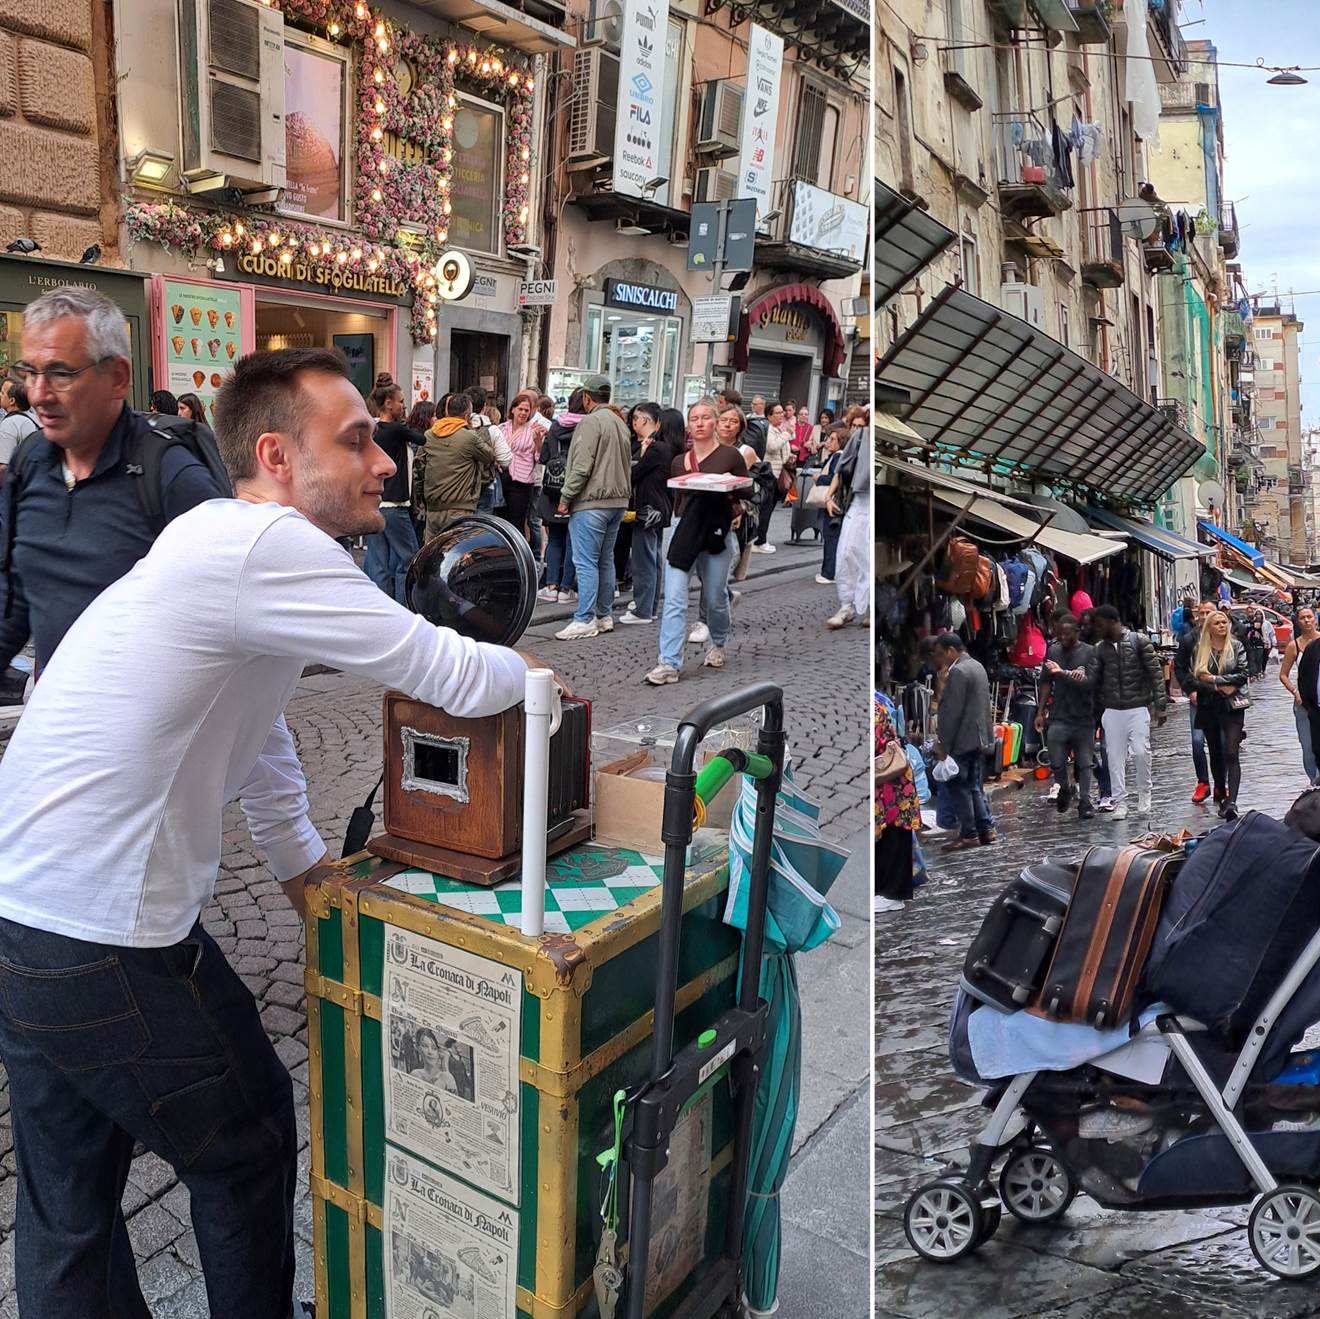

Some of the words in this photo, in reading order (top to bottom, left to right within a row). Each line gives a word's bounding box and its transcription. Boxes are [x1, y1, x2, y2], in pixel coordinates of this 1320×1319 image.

[636, 12, 653, 31] PUMA
[636, 57, 652, 69] adidas
[756, 75, 773, 97] VANS
[629, 89, 654, 105] UMBRO
[629, 104, 651, 125] FILA
[622, 150, 645, 166] Reebok
[619, 168, 647, 185] saucony
[243, 255, 291, 279] CUORI
[296, 264, 311, 281] DI
[316, 267, 407, 297] SFOGLIATELLA
[520, 281, 555, 294] PEGNI
[616, 283, 678, 310] SINISCALCHI
[410, 953, 426, 973] La
[428, 960, 464, 987] Cronaca
[466, 975, 475, 991] di
[475, 980, 512, 1005] Napoli
[480, 1101, 507, 1121] VESUVIO
[410, 1177, 426, 1198] La
[427, 1190, 463, 1216] Cronaca
[464, 1205, 473, 1223] di
[474, 1214, 509, 1242] Napoli
